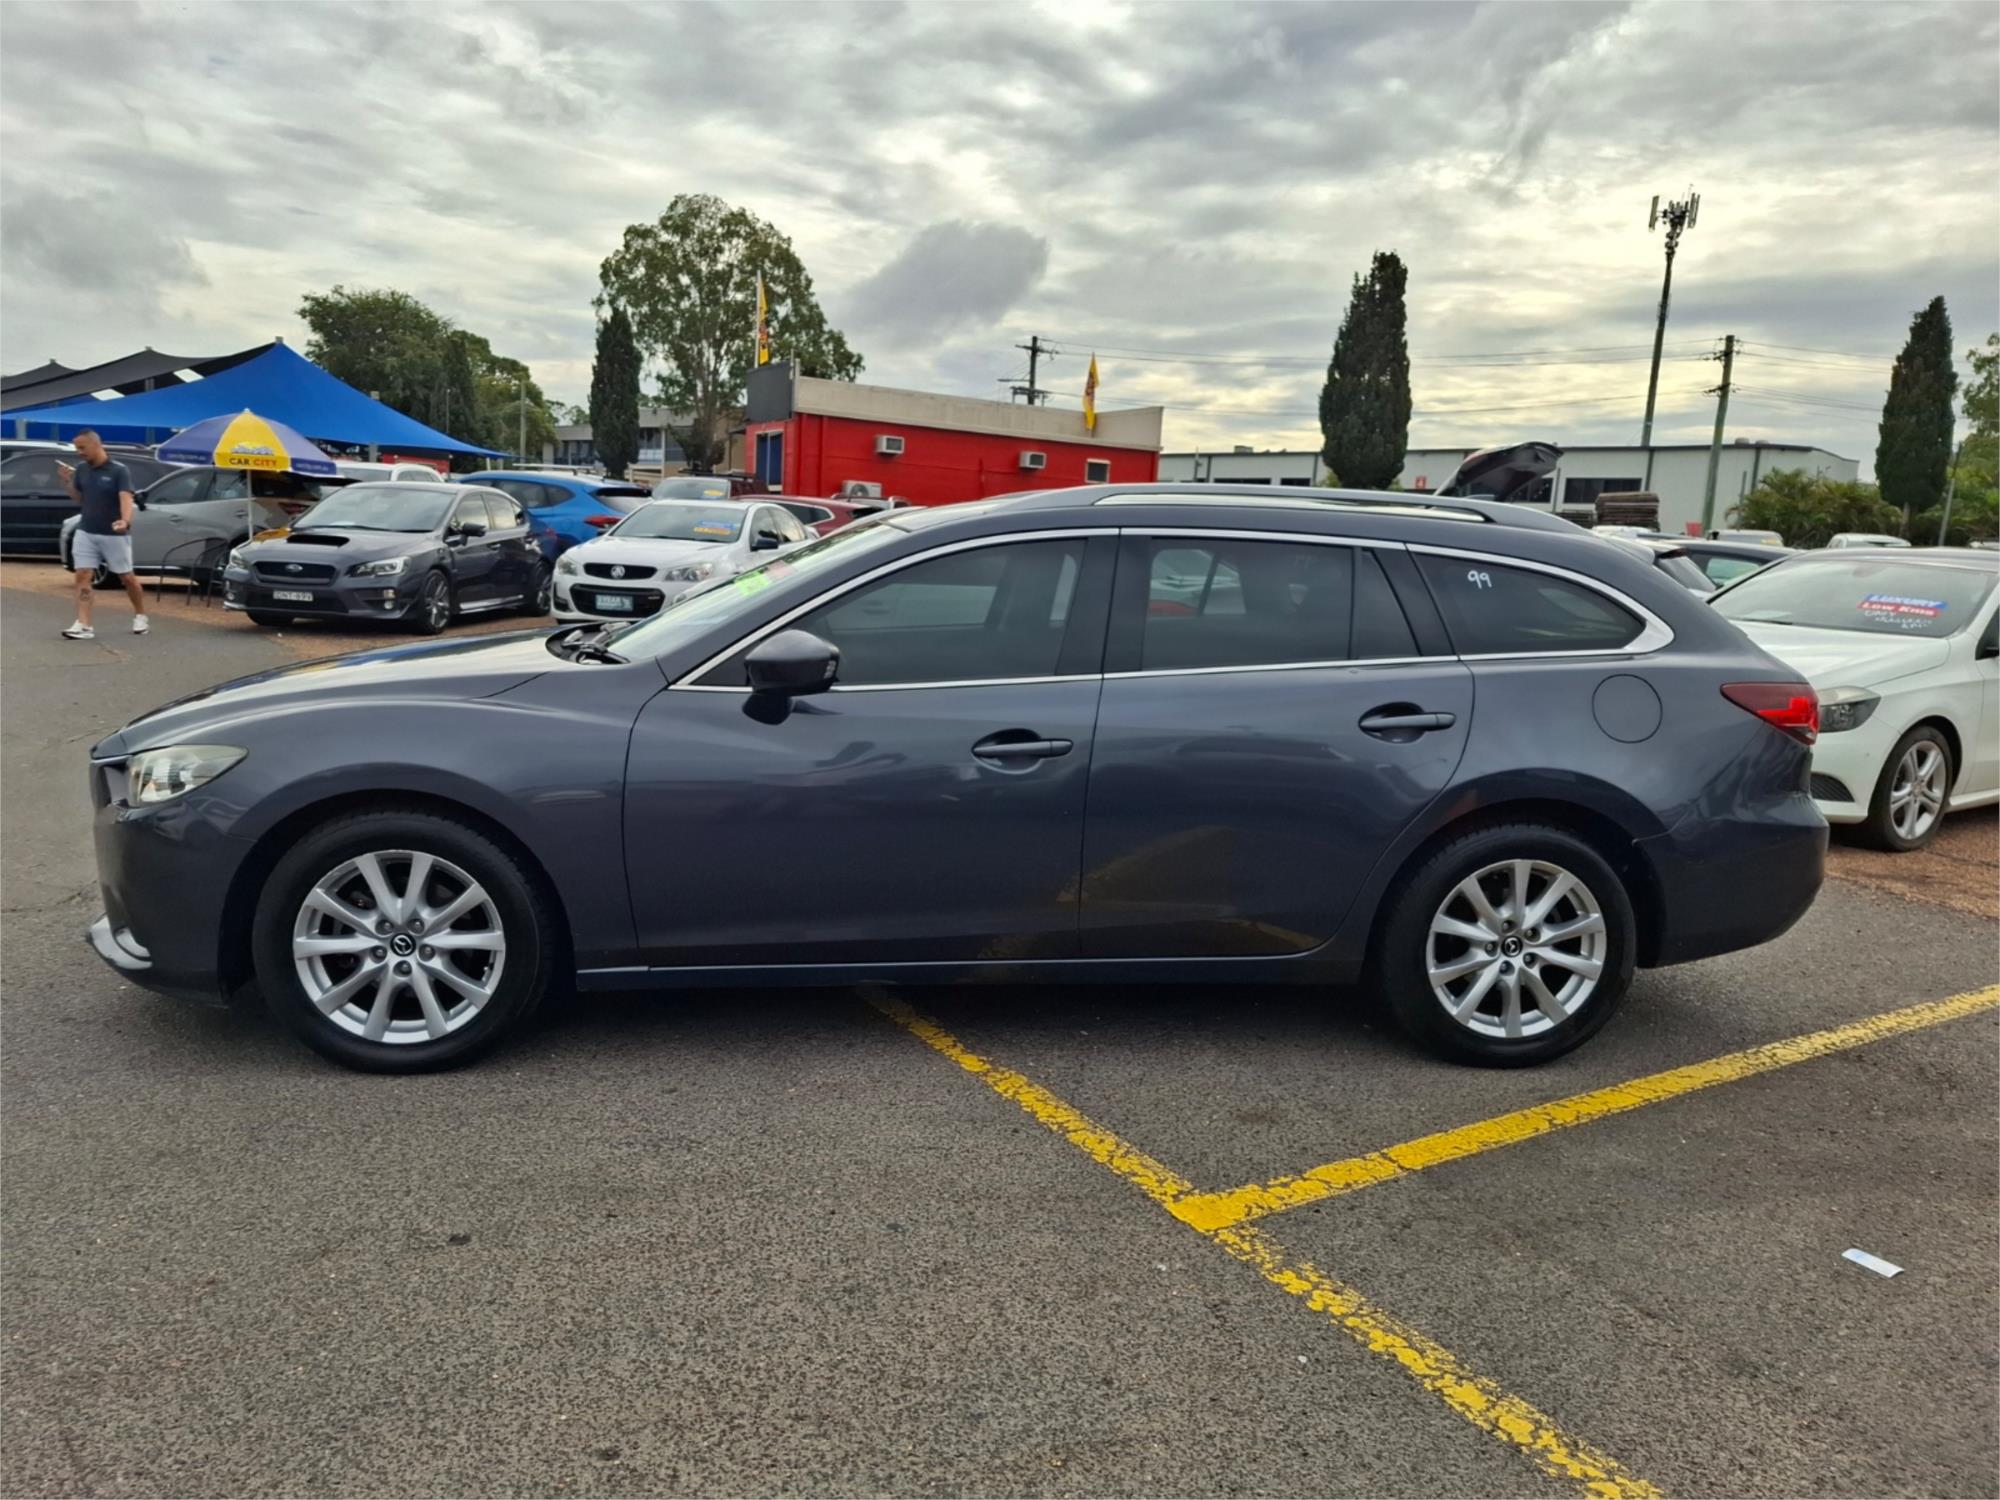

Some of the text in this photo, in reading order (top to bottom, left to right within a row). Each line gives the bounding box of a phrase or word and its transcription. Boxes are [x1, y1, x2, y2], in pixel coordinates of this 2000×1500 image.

[229, 457, 278, 467] CAR CITY
[1868, 594, 1942, 608] LUXURY
[1862, 602, 1936, 617] Low Kms
